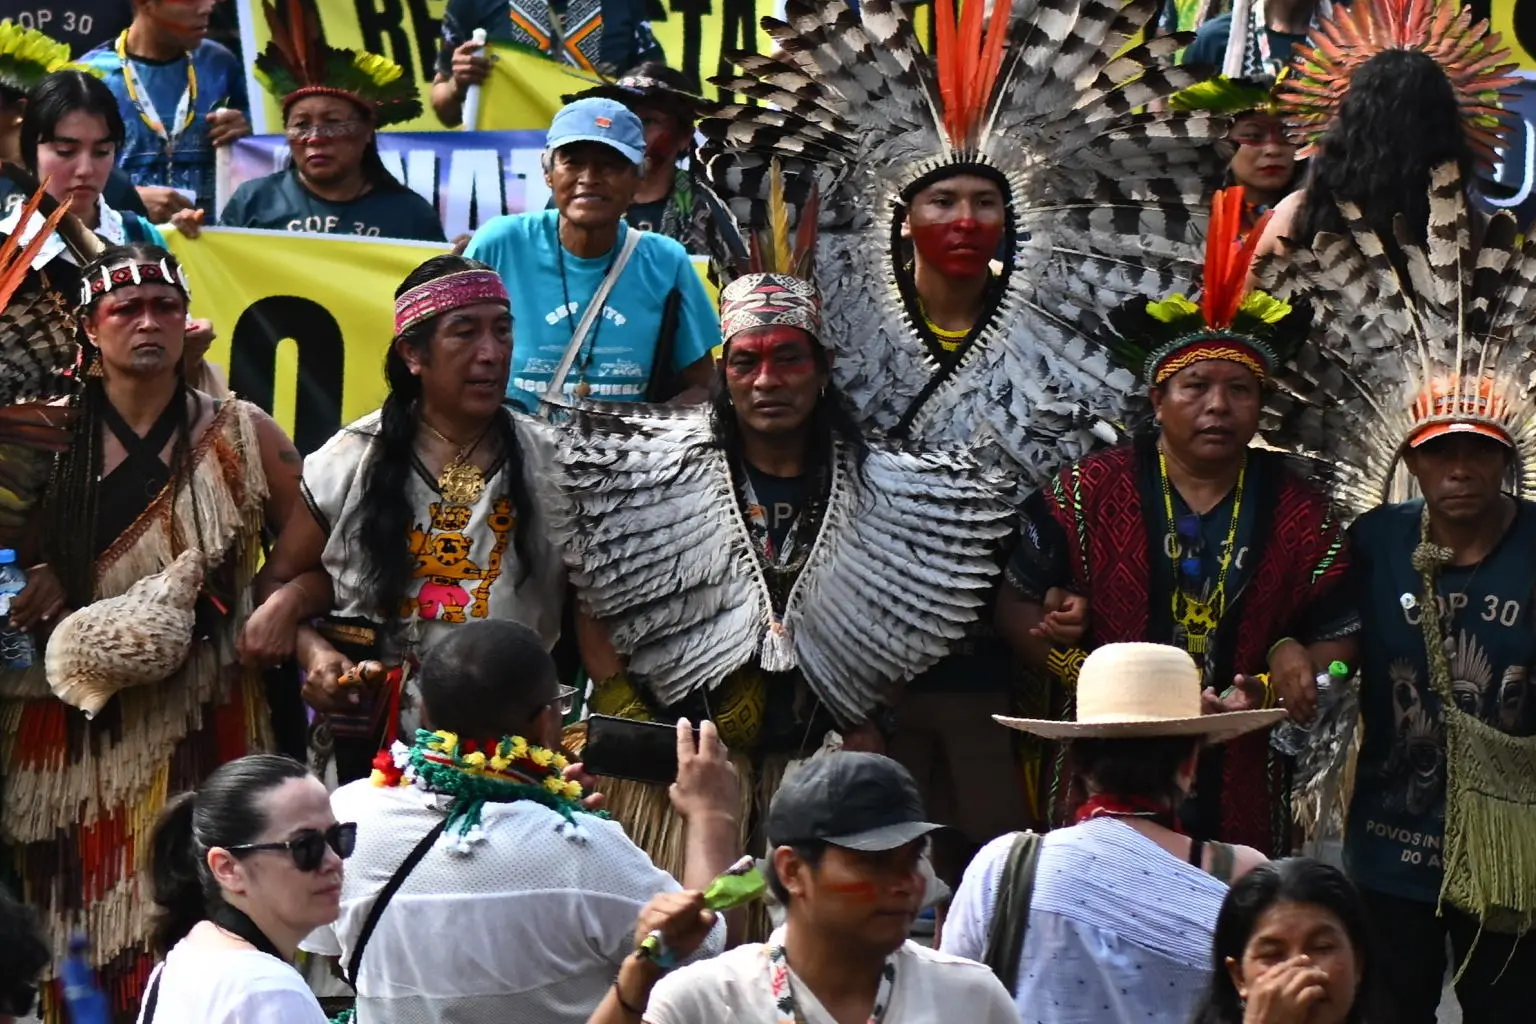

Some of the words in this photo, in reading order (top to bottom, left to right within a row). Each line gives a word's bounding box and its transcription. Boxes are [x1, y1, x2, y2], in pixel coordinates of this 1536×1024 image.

[62, 11, 94, 35] 30
[514, 377, 576, 395] ACOA
[1481, 594, 1520, 627] 30
[1365, 819, 1421, 848] POVOS
[1401, 849, 1421, 866] DO
